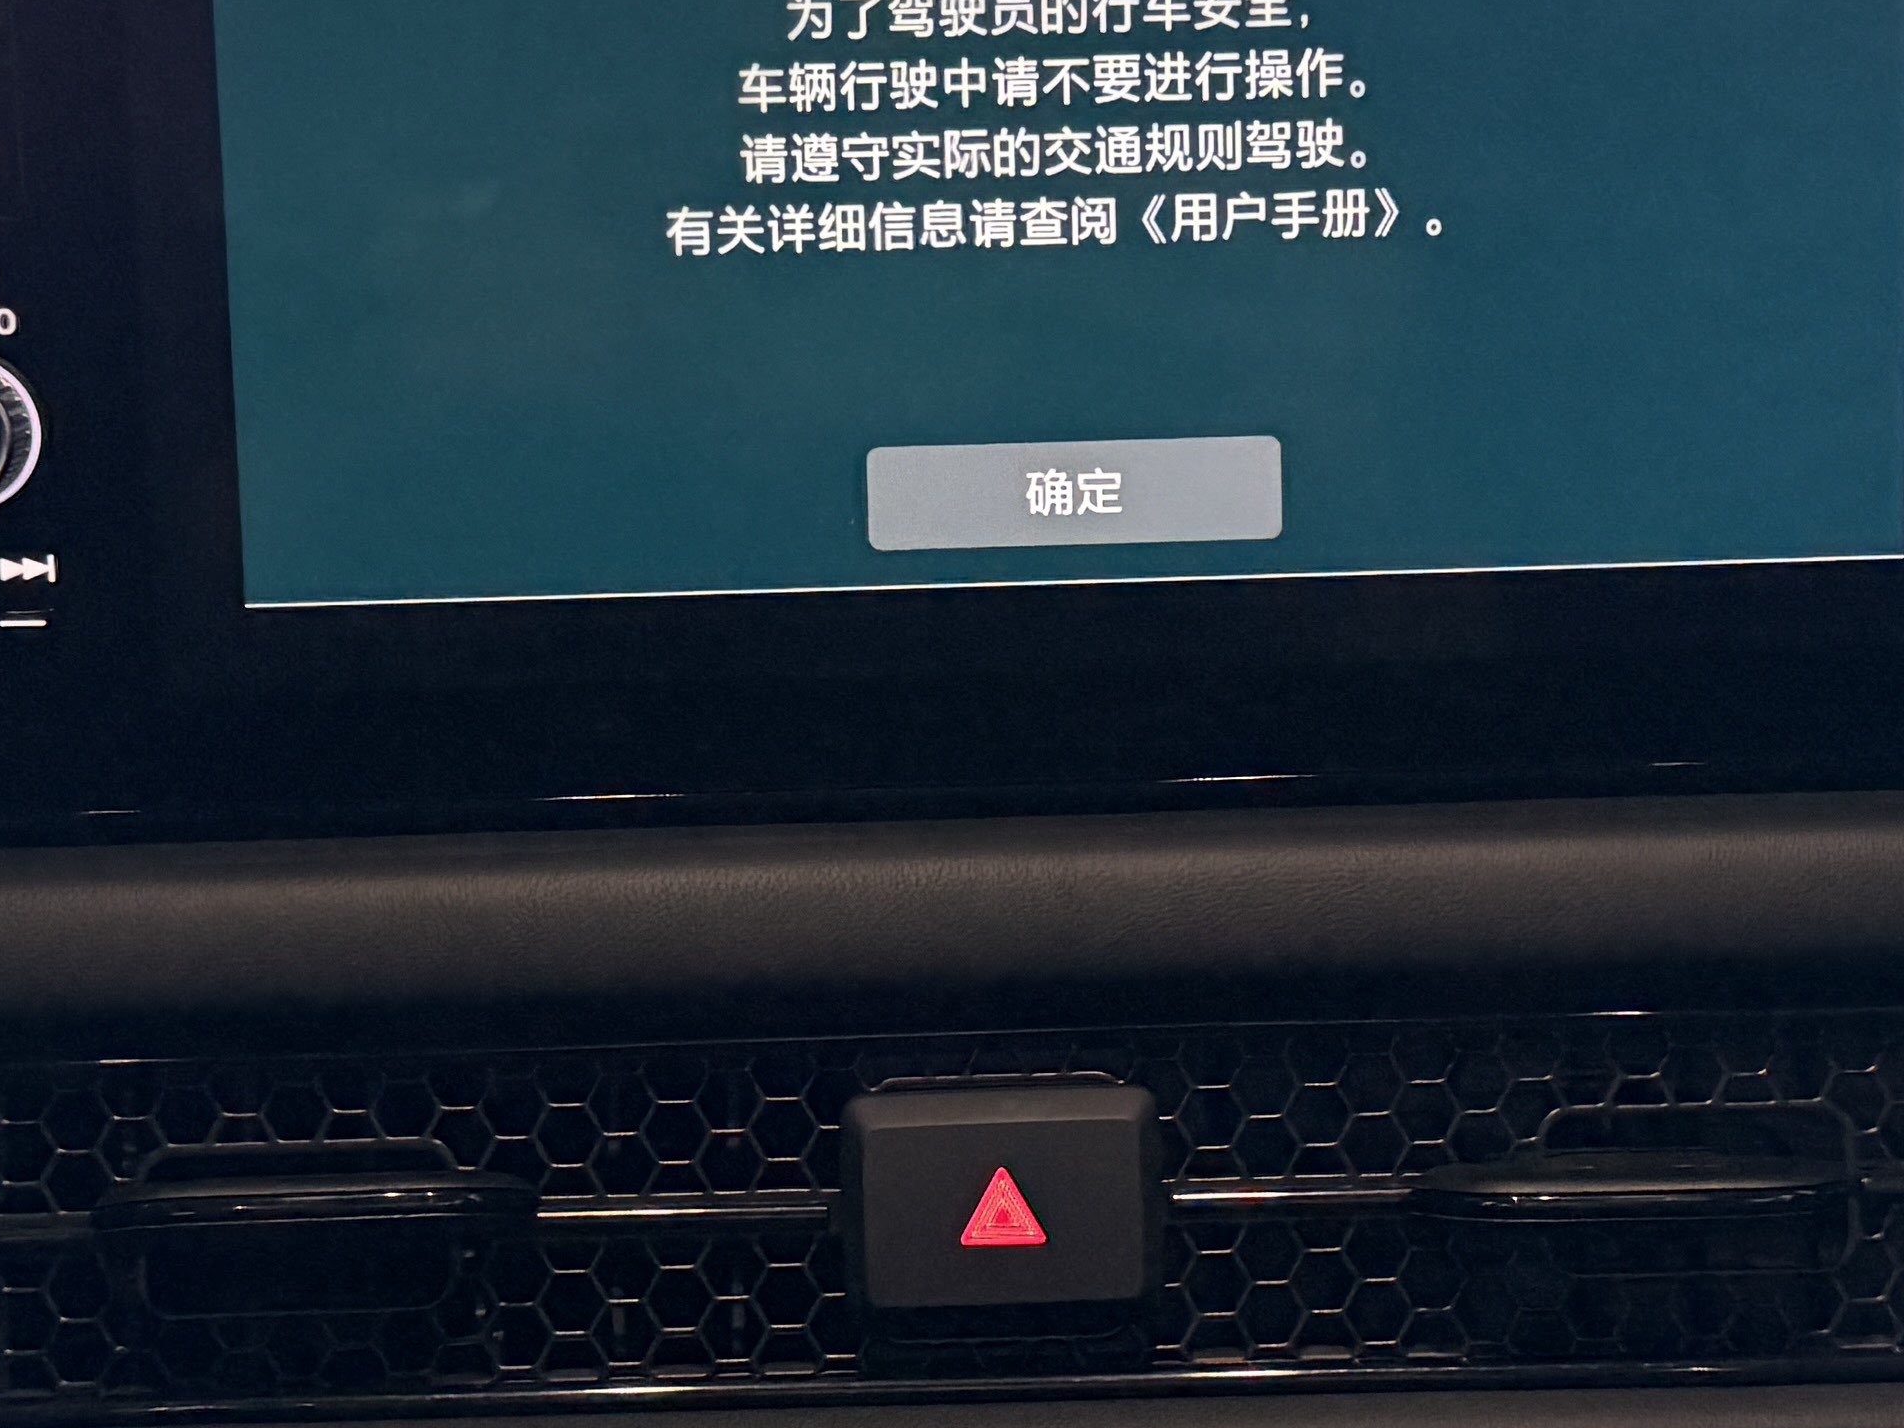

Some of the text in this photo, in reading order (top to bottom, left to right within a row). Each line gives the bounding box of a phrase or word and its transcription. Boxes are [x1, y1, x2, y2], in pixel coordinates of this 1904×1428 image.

[737, 47, 1366, 120] 车辆行驶中请不要进行操作。
[739, 119, 1368, 185] 请遵守实际的交通规则驾驶。
[665, 185, 1443, 257] 有关详细信息请查阅《用户手册》。
[1025, 466, 1123, 517] 确定
